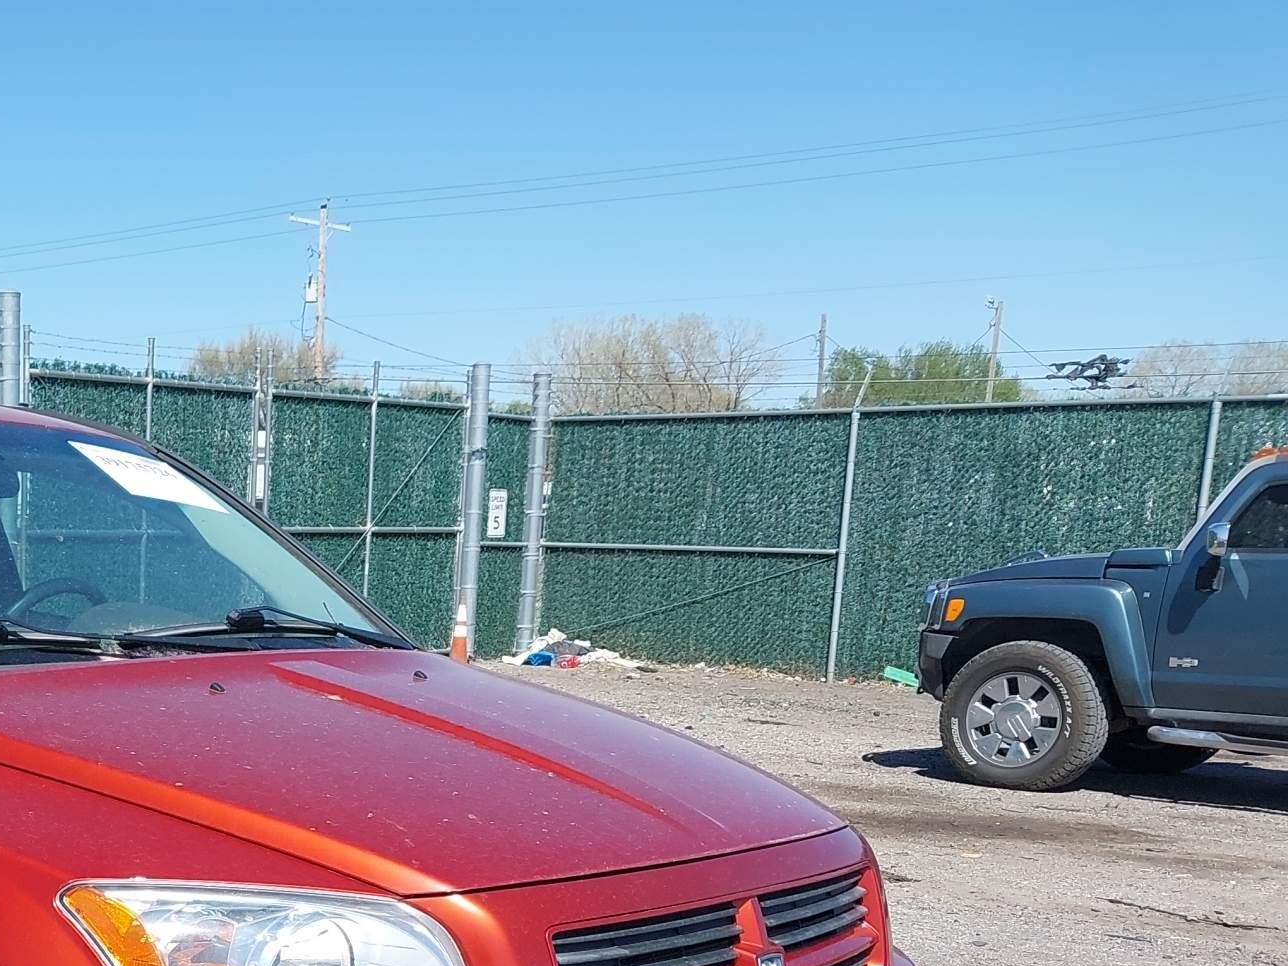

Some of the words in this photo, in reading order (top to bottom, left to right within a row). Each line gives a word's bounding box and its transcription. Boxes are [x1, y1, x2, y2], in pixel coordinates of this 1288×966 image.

[491, 495, 505, 503] SPEED
[491, 503, 504, 511] LIMIT
[492, 515, 500, 531] 5
[1063, 717, 1073, 739] A/T
